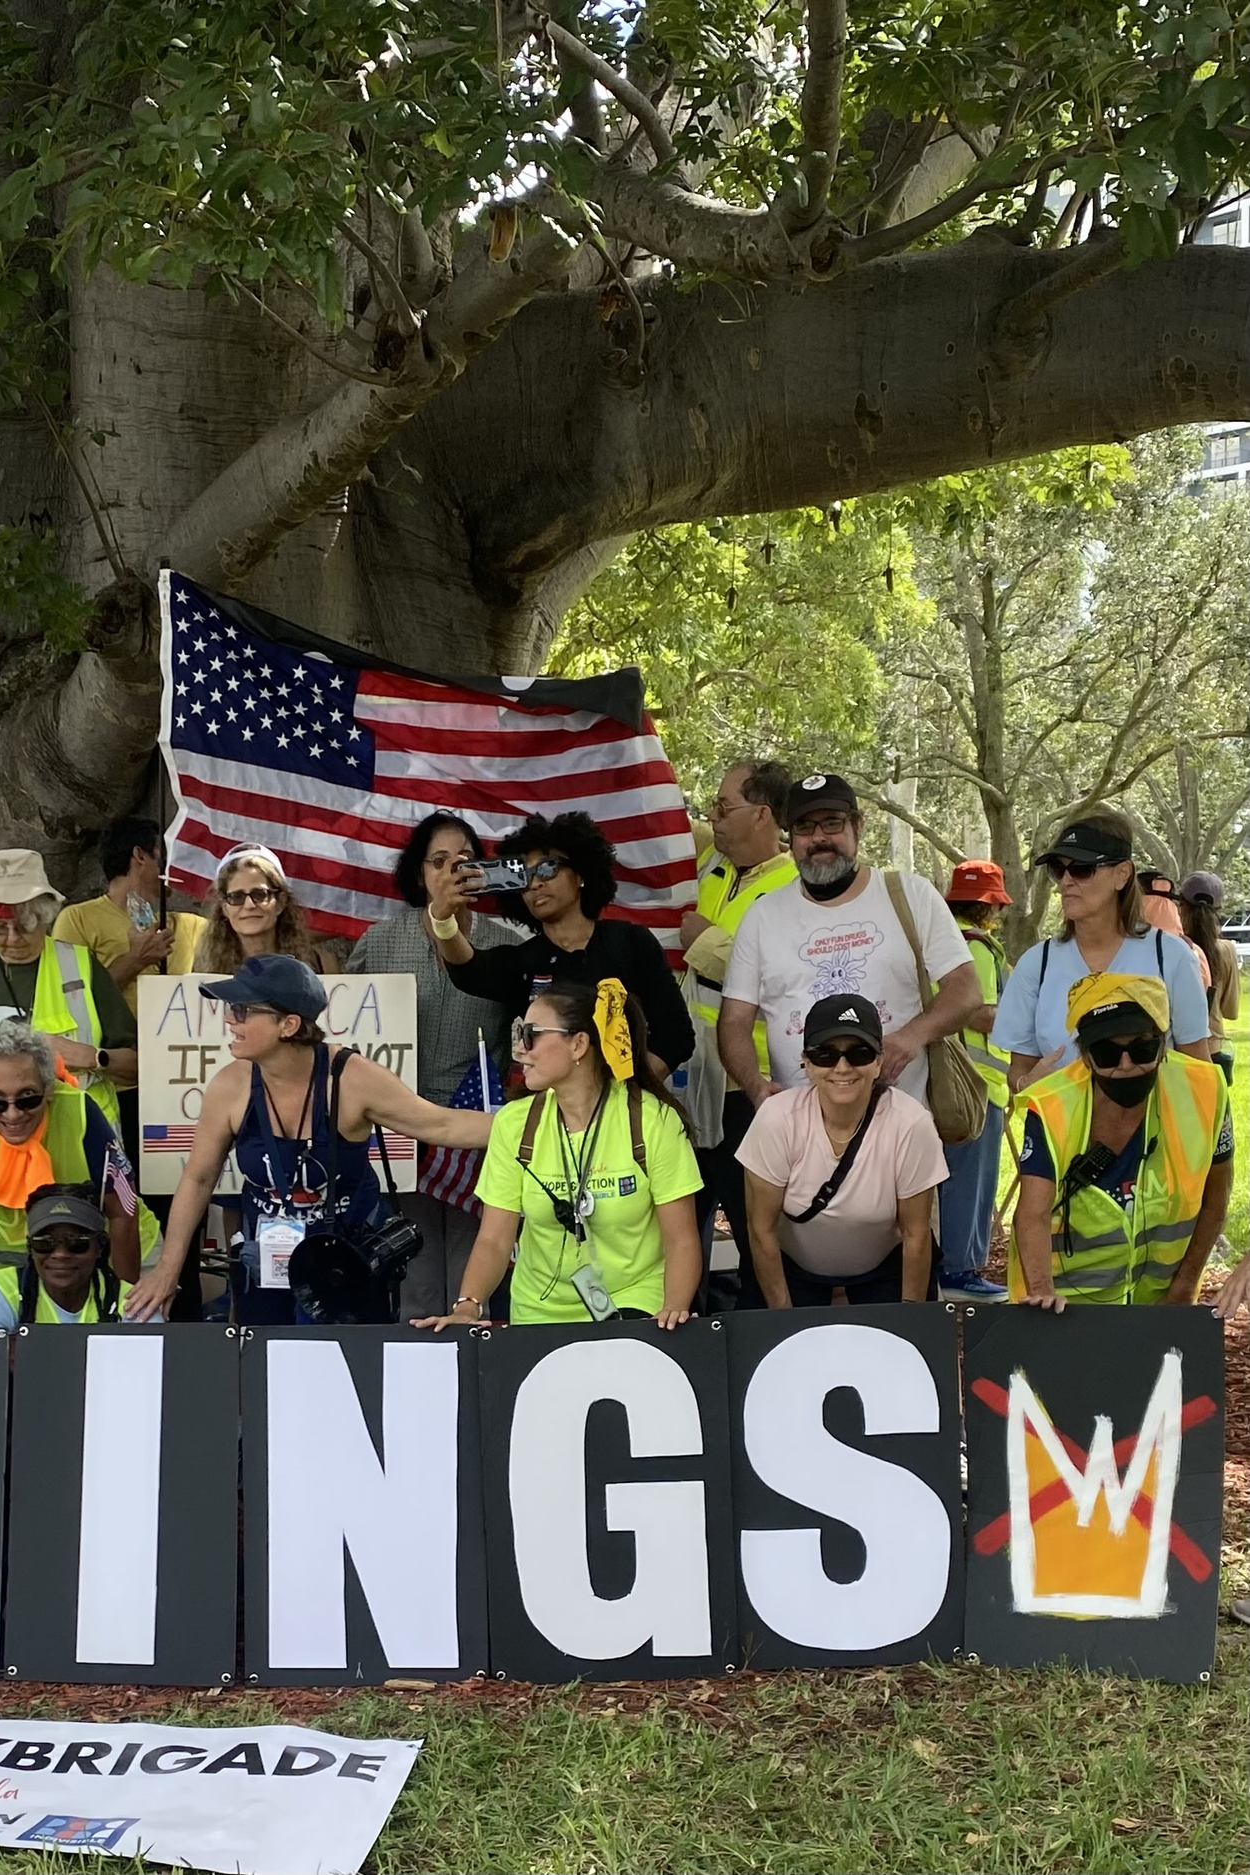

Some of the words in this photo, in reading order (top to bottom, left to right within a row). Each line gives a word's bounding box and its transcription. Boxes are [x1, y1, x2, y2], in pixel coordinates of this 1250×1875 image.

[807, 945, 833, 956] SHOULD
[833, 942, 851, 952] COST
[852, 936, 875, 948] MONEY
[815, 938, 830, 947] ONLY
[831, 936, 845, 944] FUN
[845, 930, 867, 941] DRUGS
[156, 982, 382, 1038] AMCA
[168, 1044, 221, 1085] IF
[586, 1177, 615, 1190] CTION
